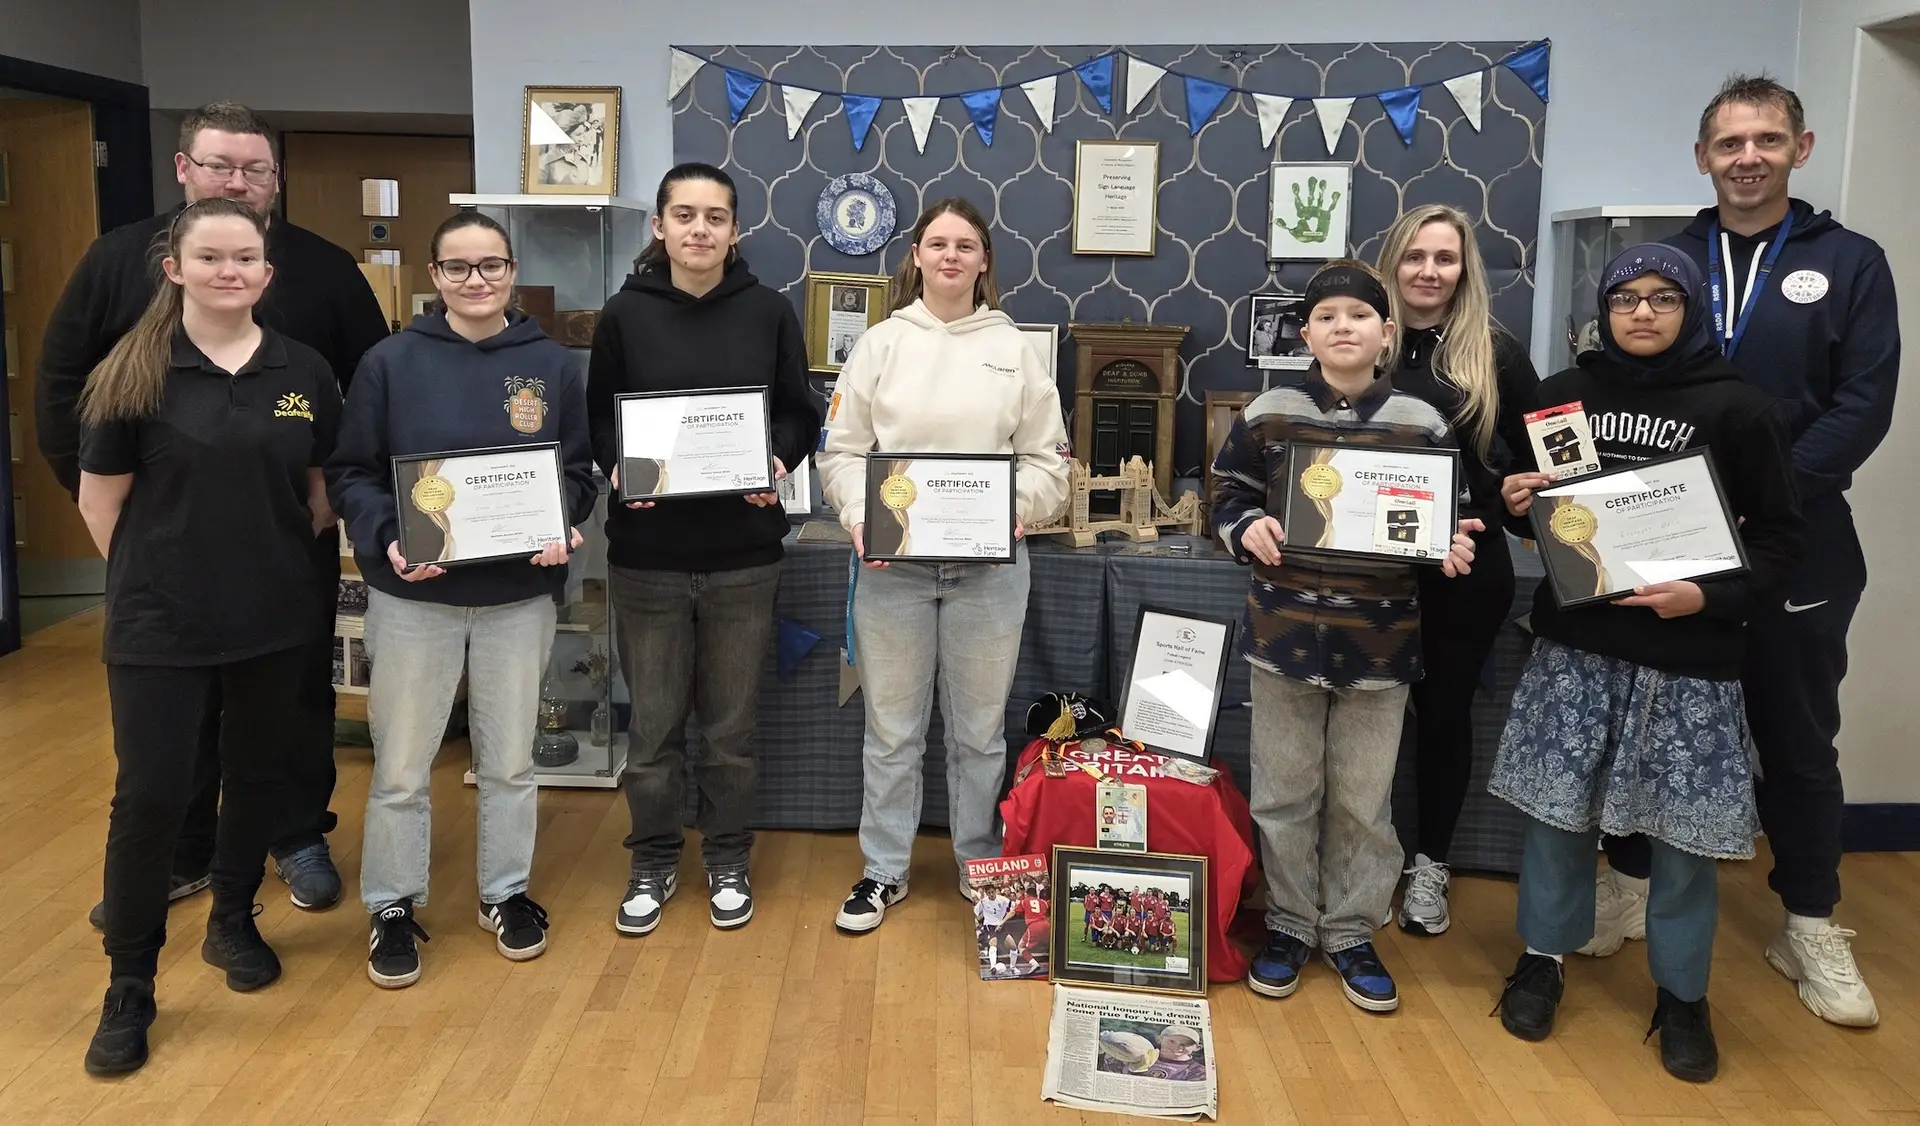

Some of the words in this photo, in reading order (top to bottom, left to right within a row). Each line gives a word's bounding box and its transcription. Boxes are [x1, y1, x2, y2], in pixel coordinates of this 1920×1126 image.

[514, 398, 538, 406] DESERT
[515, 413, 537, 421] ROLLER
[520, 420, 535, 428] CLUB
[681, 412, 745, 424] CERTIFICATE
[1589, 412, 1695, 452] OODRICH
[465, 470, 536, 485] CERTIFICATE
[927, 479, 991, 488] CERTIFICATE
[1354, 471, 1429, 484] CERTIFICATE
[483, 480, 530, 490] PARTICIPATION
[1372, 481, 1421, 489] PARTICIPATION
[1605, 483, 1687, 509] CERTIFICATE
[1627, 495, 1681, 512] PARTICIPATION
[1156, 641, 1173, 649] Sports
[1069, 750, 1169, 765] GREAT
[968, 859, 1030, 876] ENGLAND
[1029, 899, 1041, 914] 9
[1066, 1007, 1095, 1016] come
[1099, 1010, 1121, 1018] true
[1143, 1016, 1176, 1025] young
[1179, 1019, 1200, 1027] star
[1067, 1001, 1109, 1011] National
[1113, 1005, 1150, 1015] honour
[1153, 1009, 1162, 1017] is
[1166, 1011, 1201, 1020] dream
